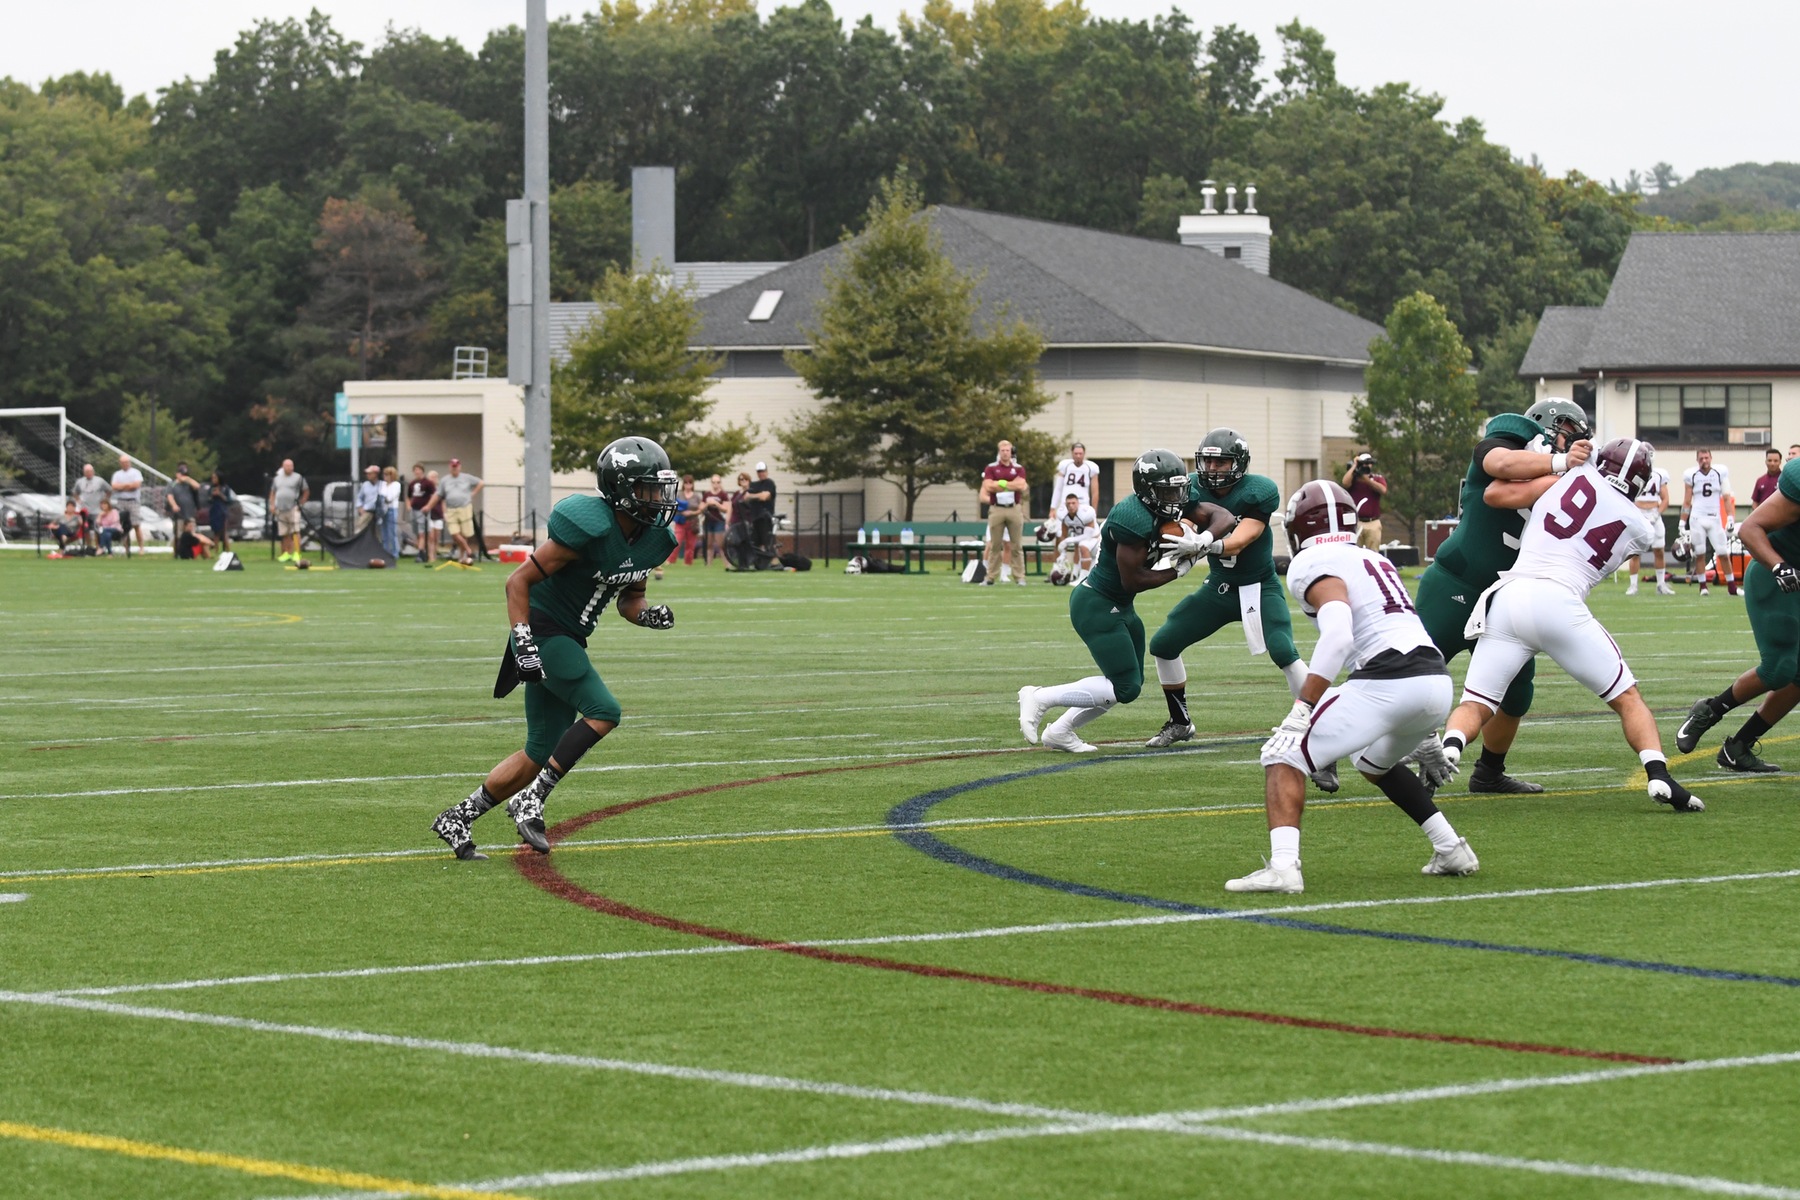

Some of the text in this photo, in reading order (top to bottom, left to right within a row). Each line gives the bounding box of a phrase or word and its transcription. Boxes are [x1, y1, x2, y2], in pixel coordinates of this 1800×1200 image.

[1066, 472, 1085, 488] 84
[1607, 476, 1628, 490] schutt
[1702, 482, 1713, 497] 6
[1544, 474, 1627, 571] 94
[1315, 534, 1351, 544] Riddell
[1363, 559, 1418, 615] 10
